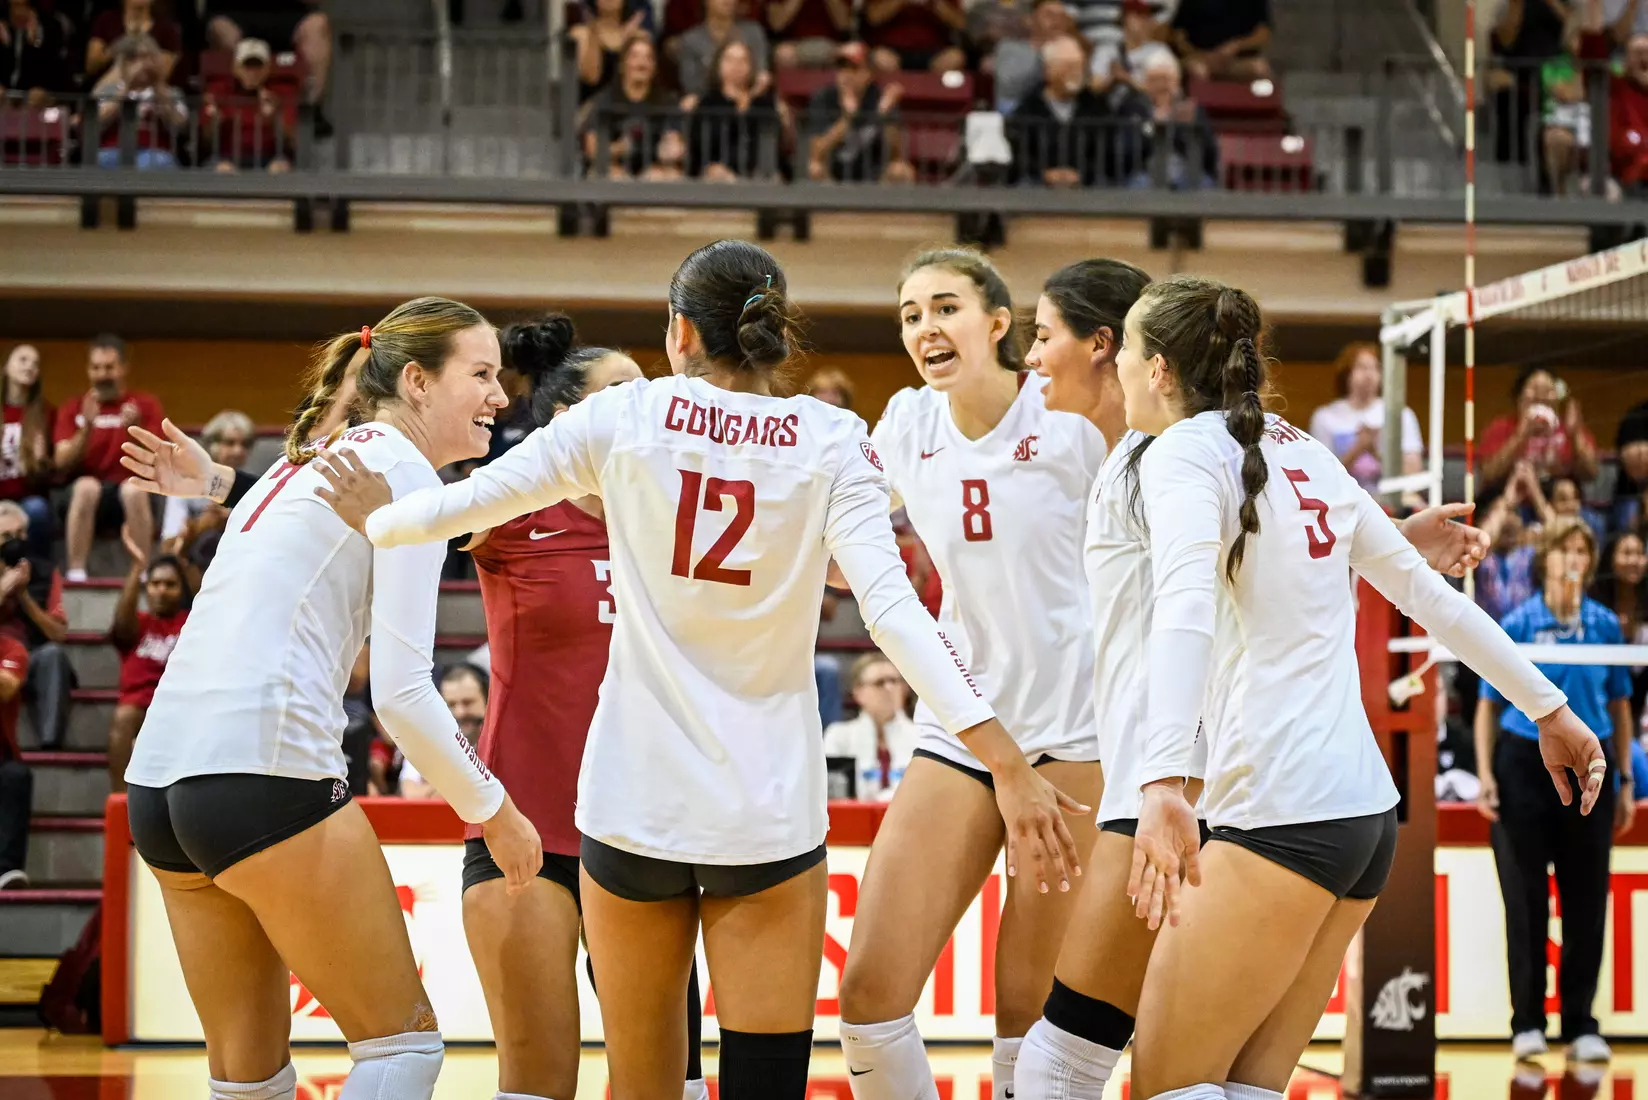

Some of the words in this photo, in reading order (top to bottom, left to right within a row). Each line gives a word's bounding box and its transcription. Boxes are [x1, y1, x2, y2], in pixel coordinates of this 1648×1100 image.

[665, 396, 798, 446] COUGARS
[240, 462, 305, 533] 7
[671, 469, 755, 586] 12
[961, 479, 992, 542] 8
[1281, 467, 1337, 560] 5
